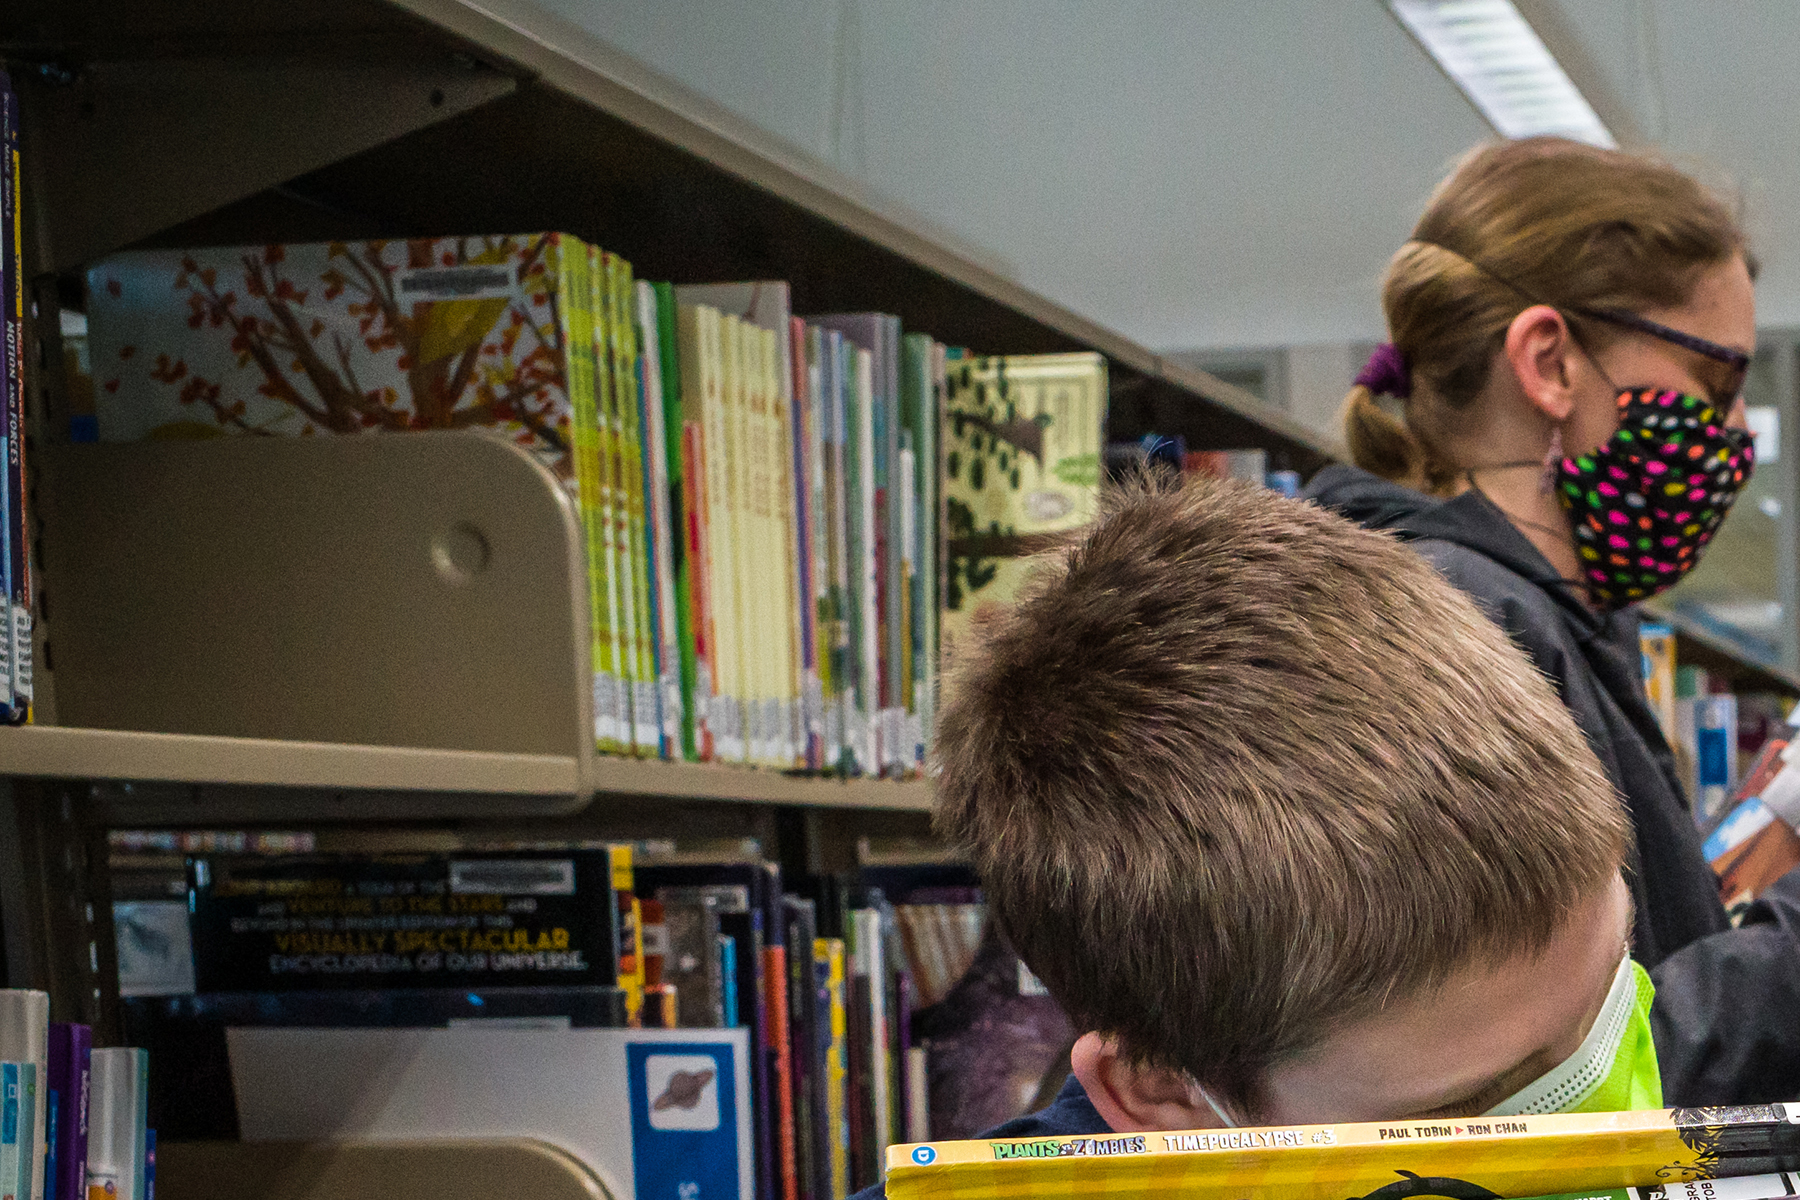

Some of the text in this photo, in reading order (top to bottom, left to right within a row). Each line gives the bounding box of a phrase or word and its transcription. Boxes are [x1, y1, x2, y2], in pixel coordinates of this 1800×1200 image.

[6, 320, 17, 378] MOTION
[8, 412, 20, 465] FORCES
[394, 927, 571, 952] SPECTACULAR
[415, 953, 441, 971] OF
[992, 1122, 1528, 1160] PLANTS ZOMBIES TIMEPOCALYPSE #3 PAUL TOBIN RON CHAN
